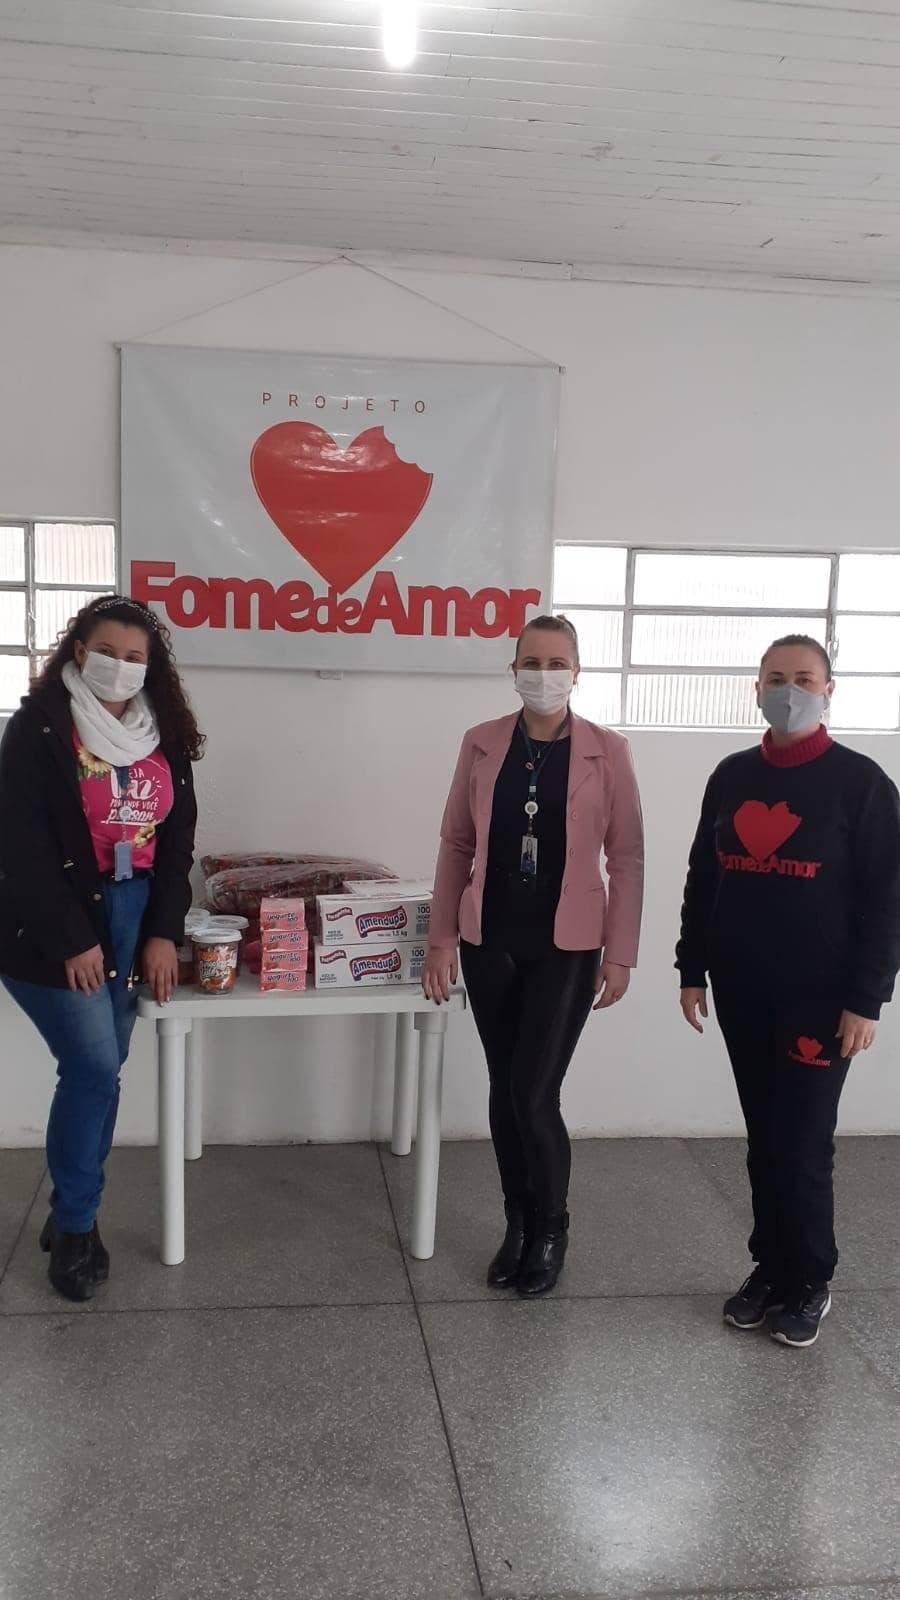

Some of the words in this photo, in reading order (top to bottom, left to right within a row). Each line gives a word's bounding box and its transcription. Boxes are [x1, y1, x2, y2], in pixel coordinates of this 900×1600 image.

[262, 392, 426, 413] PROJETO
[417, 906, 431, 914] 100
[411, 949, 425, 957] 100
